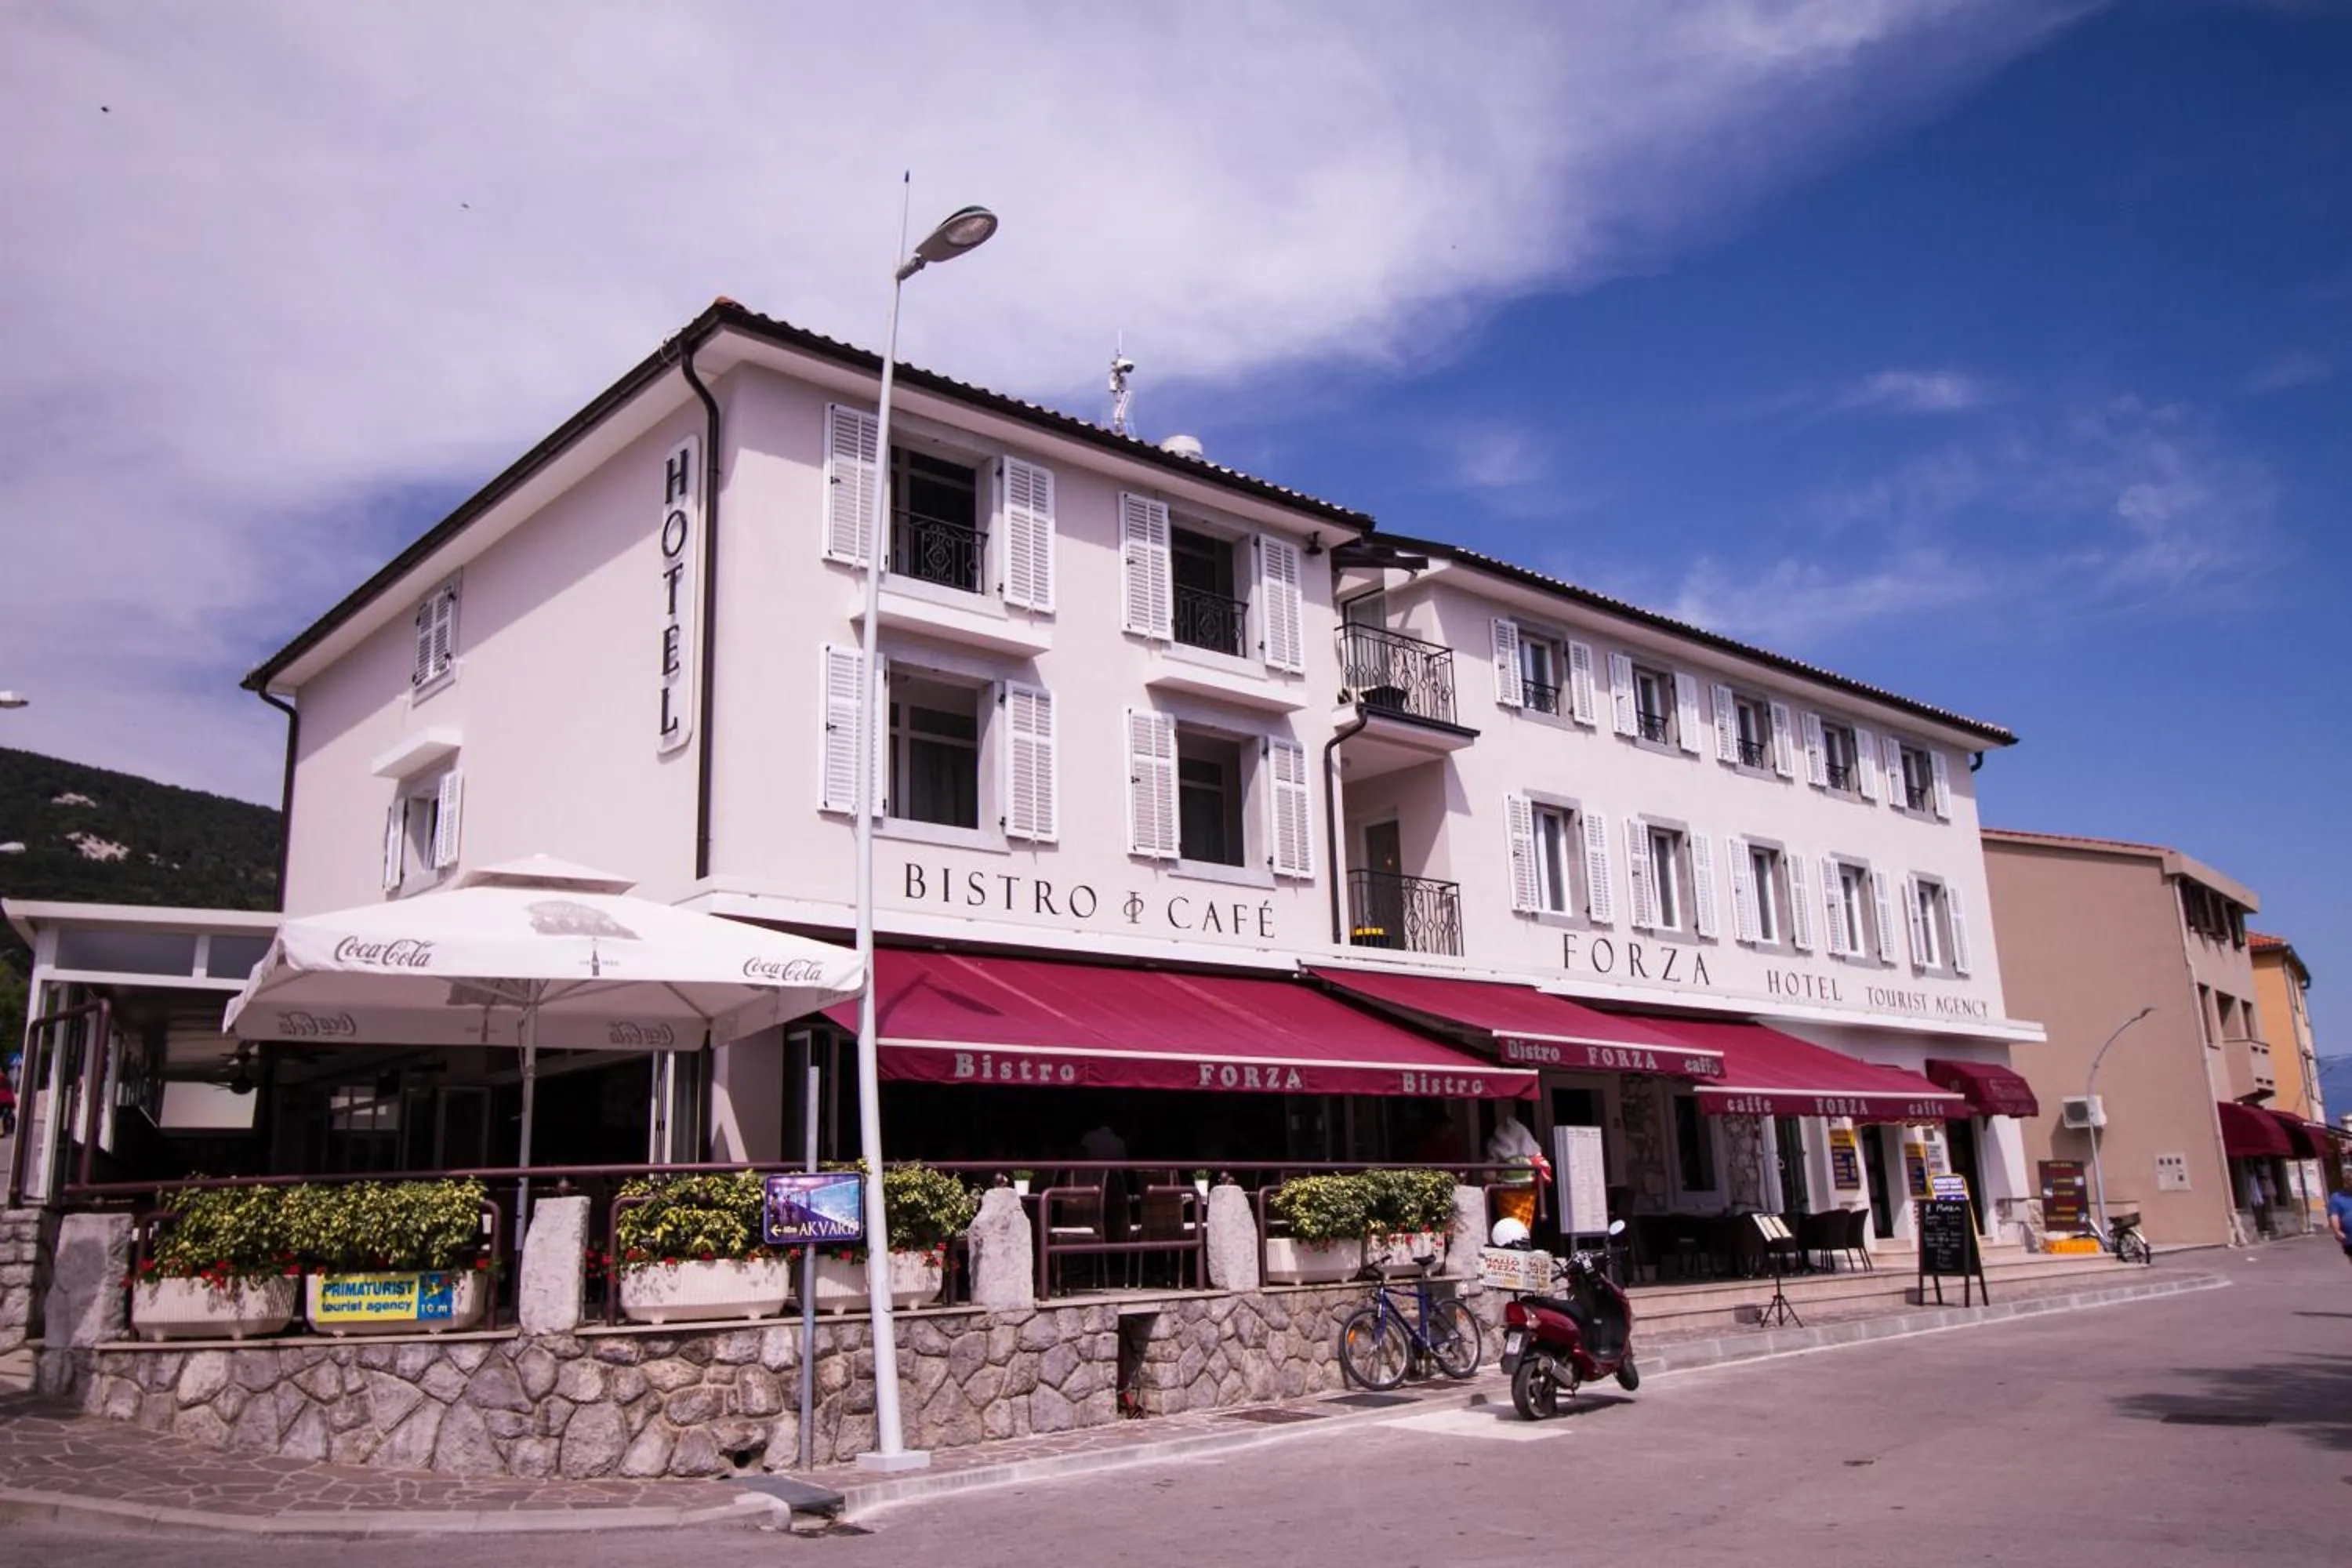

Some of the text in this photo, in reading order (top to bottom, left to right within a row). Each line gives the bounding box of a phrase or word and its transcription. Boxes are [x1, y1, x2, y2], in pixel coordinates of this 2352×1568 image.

[659, 448, 689, 736] HOTEL
[904, 862, 1098, 919] BISTRO
[1167, 897, 1276, 939] CAFÉ
[1563, 933, 1989, 1018] FORZA HOTEL TOURIST AGENCY
[953, 1052, 1483, 1094] Bistro FORZA Bistro
[1587, 1046, 1659, 1070] FORZA
[1726, 1096, 1773, 1113] caffe
[1816, 1098, 1869, 1115] FORZA
[321, 1279, 415, 1298] PRIMATURIST
[321, 1300, 413, 1313] tourist agency
